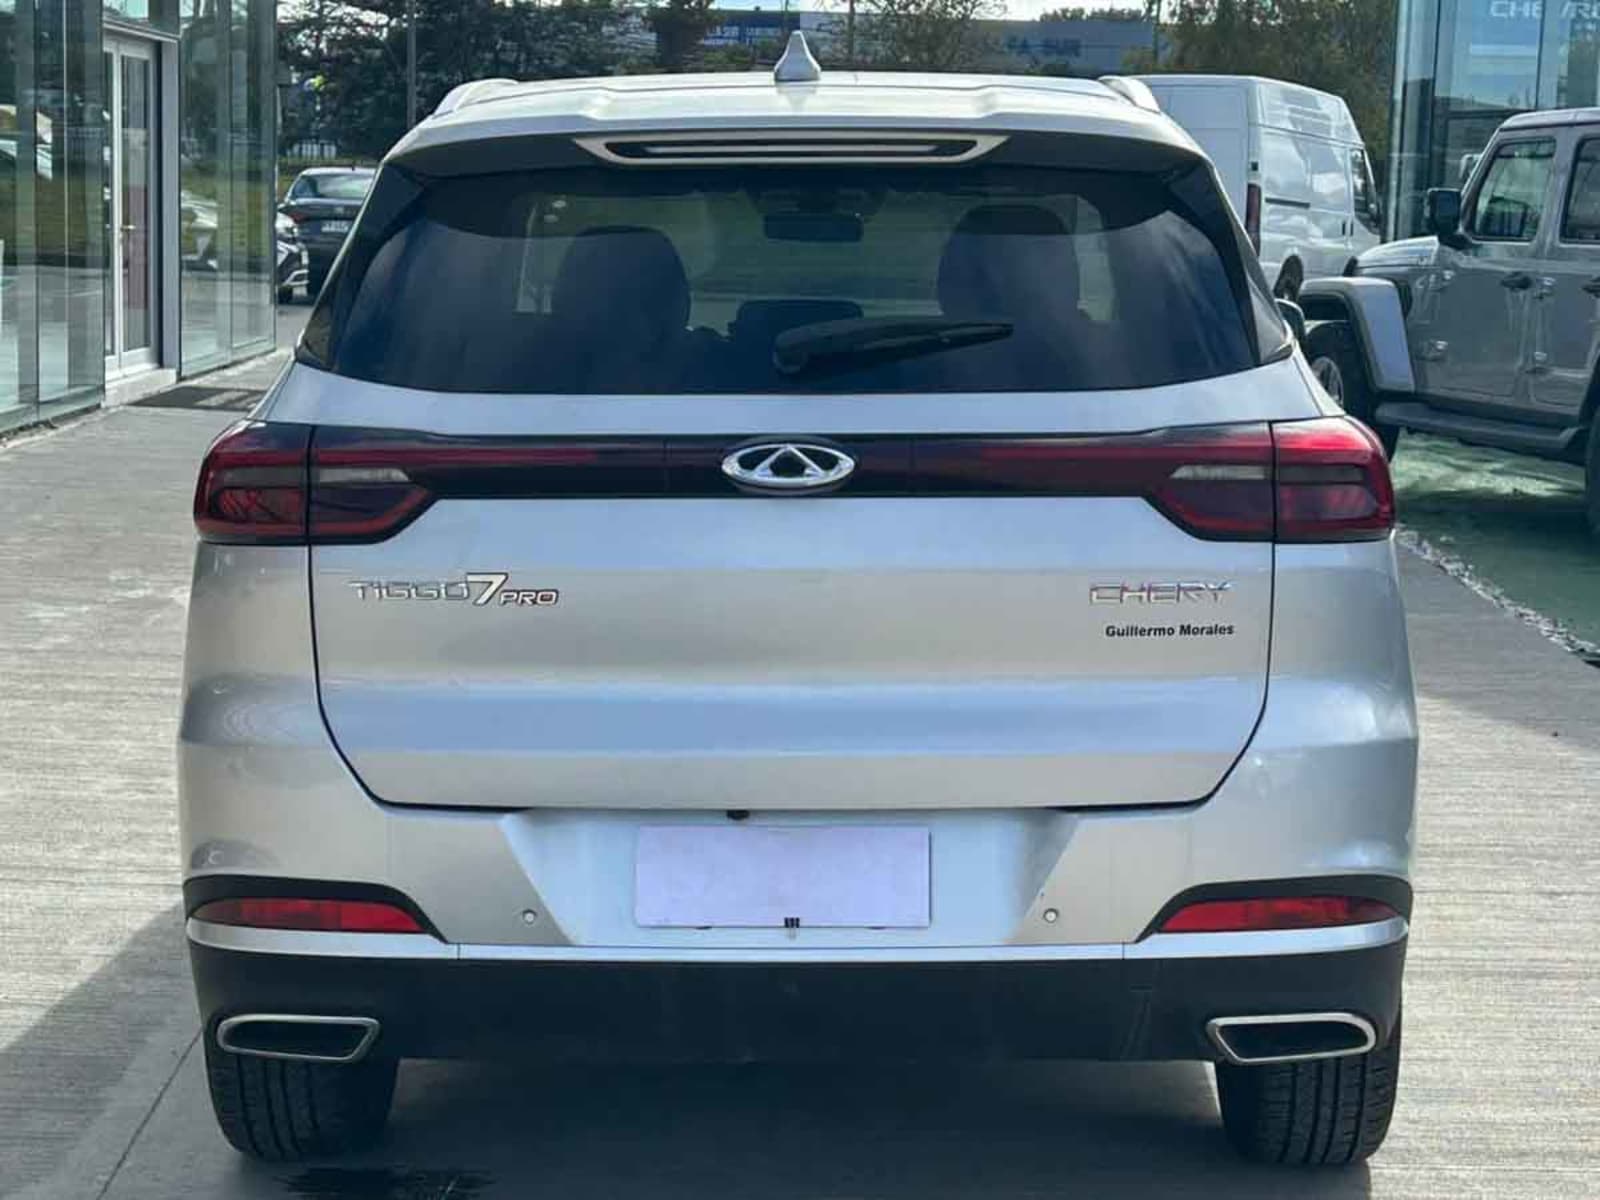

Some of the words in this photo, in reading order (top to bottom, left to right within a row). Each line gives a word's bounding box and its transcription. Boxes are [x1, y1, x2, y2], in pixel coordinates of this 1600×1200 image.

[1089, 582, 1233, 604] CHERY
[1105, 625, 1175, 637] Guillermo
[1179, 624, 1235, 636] Morales
